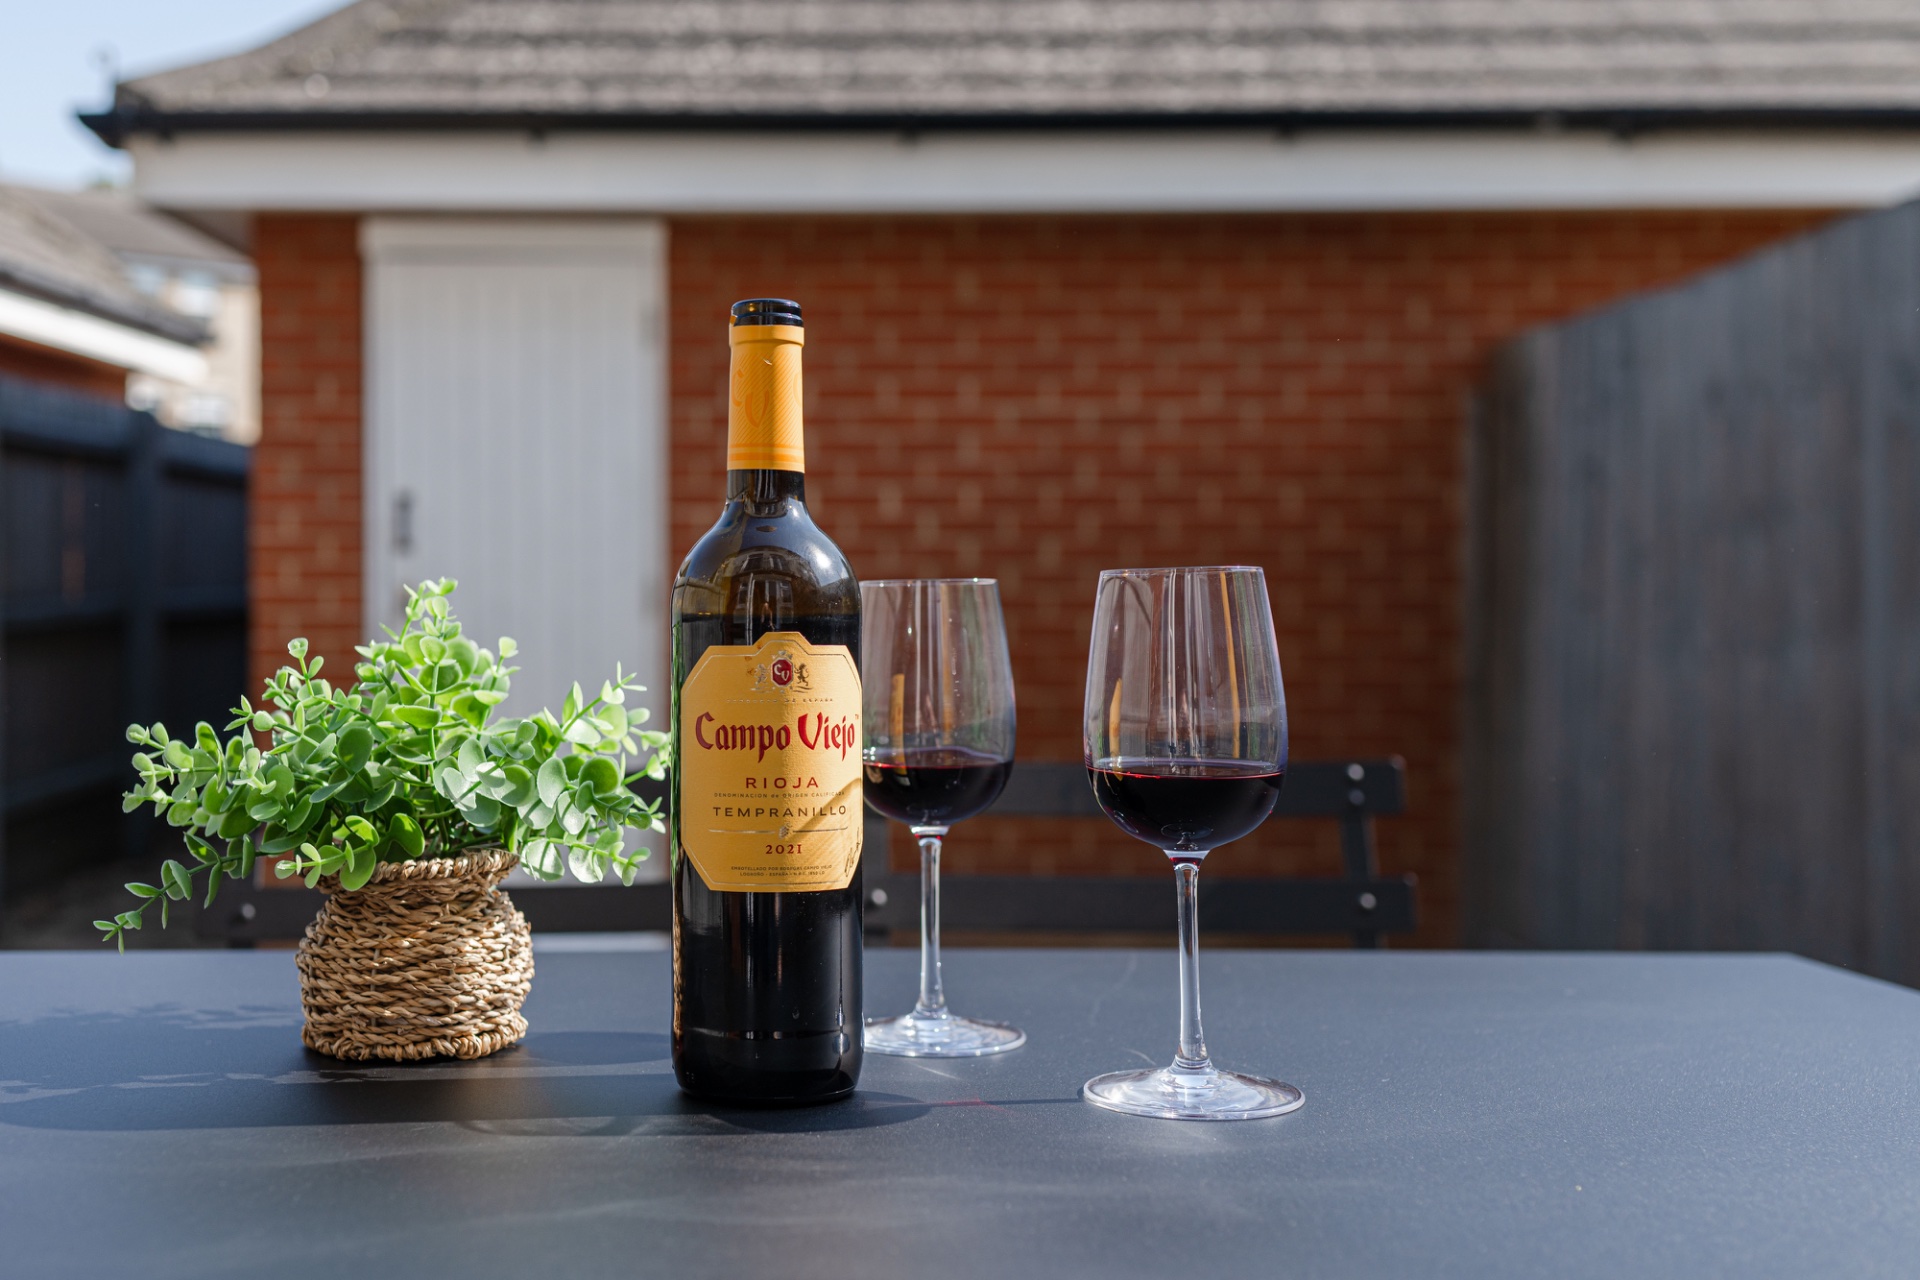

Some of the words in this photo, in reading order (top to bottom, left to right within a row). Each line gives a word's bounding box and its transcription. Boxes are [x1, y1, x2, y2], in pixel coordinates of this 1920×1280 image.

[773, 664, 790, 681] CV
[695, 711, 791, 764] Campo
[797, 711, 855, 762] Viejo
[745, 776, 819, 789] RIOJA
[713, 805, 847, 818] TEMPRANILLO
[765, 844, 803, 855] 2021
